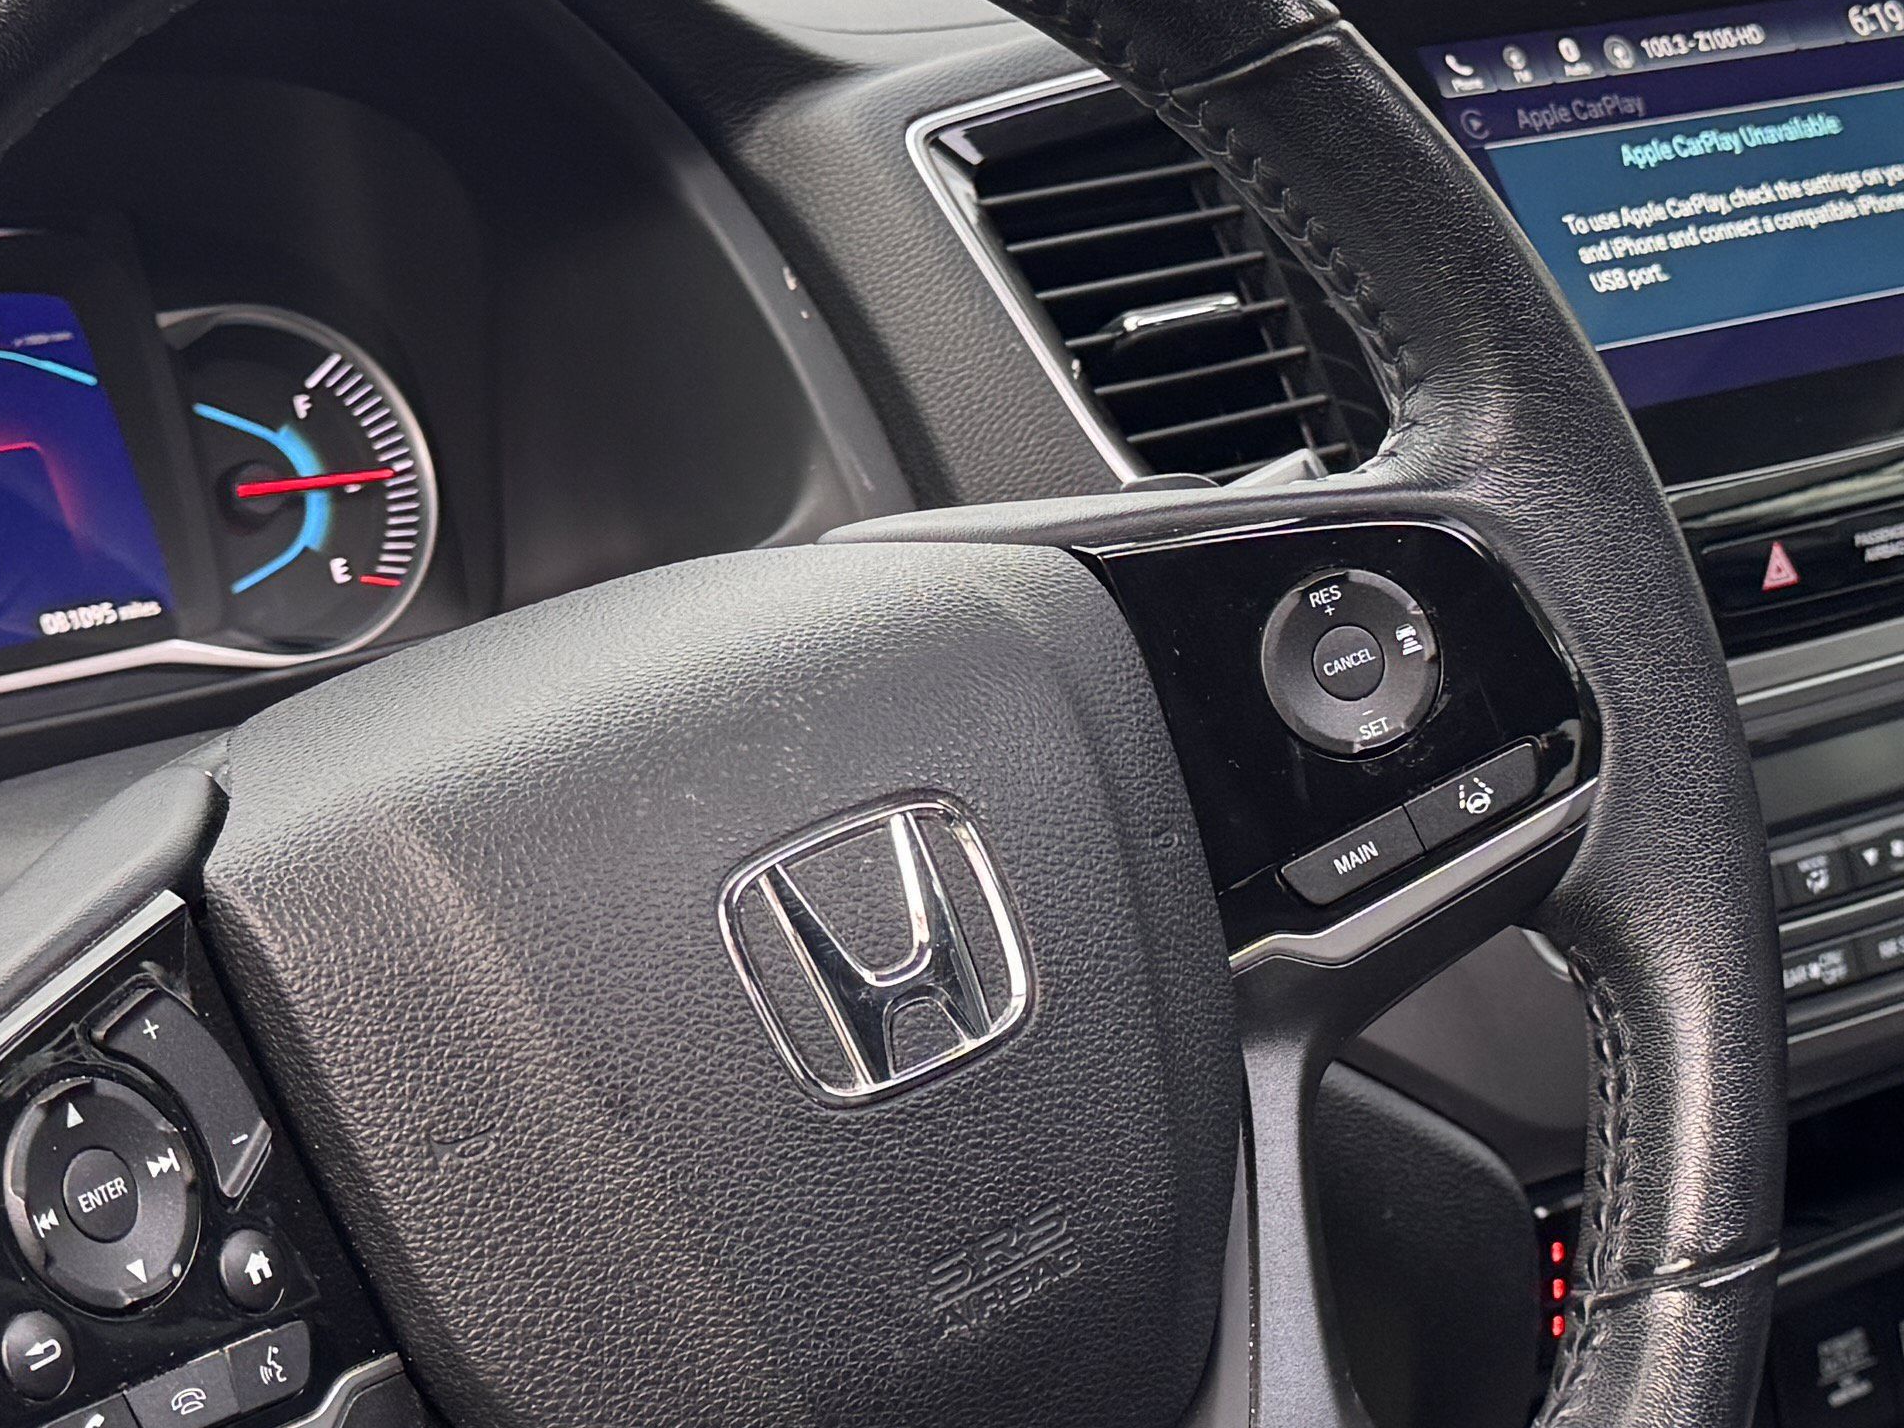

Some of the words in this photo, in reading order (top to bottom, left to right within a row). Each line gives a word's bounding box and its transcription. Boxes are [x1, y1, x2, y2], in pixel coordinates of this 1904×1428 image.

[1517, 103, 1574, 131] Apple
[1571, 93, 1646, 124] CarPlay
[1621, 133, 1674, 169] Apple
[1672, 127, 1744, 158] CarPlay
[1741, 113, 1844, 149] Unavailable
[1562, 214, 1588, 235] To
[1591, 211, 1621, 232] use
[1621, 201, 1668, 230] Apple
[1729, 185, 1776, 209] check
[1773, 179, 1803, 201] the
[1804, 171, 1864, 197] settings
[1861, 166, 1885, 187] on
[1578, 241, 1611, 264] and
[1610, 229, 1669, 258] iPhone
[1667, 225, 1700, 249] and
[1699, 214, 1762, 242] connect
[1762, 216, 1775, 232] a
[1773, 200, 1857, 230] compatible
[1589, 269, 1625, 293] USB
[293, 393, 312, 419] F
[330, 557, 352, 584] E
[1309, 584, 1342, 609] RES
[1323, 648, 1376, 677] CANCEL
[1359, 716, 1390, 740] SET
[1333, 841, 1379, 875] MAIN
[77, 1176, 128, 1214] ENTER
[928, 1203, 1068, 1302] SRS
